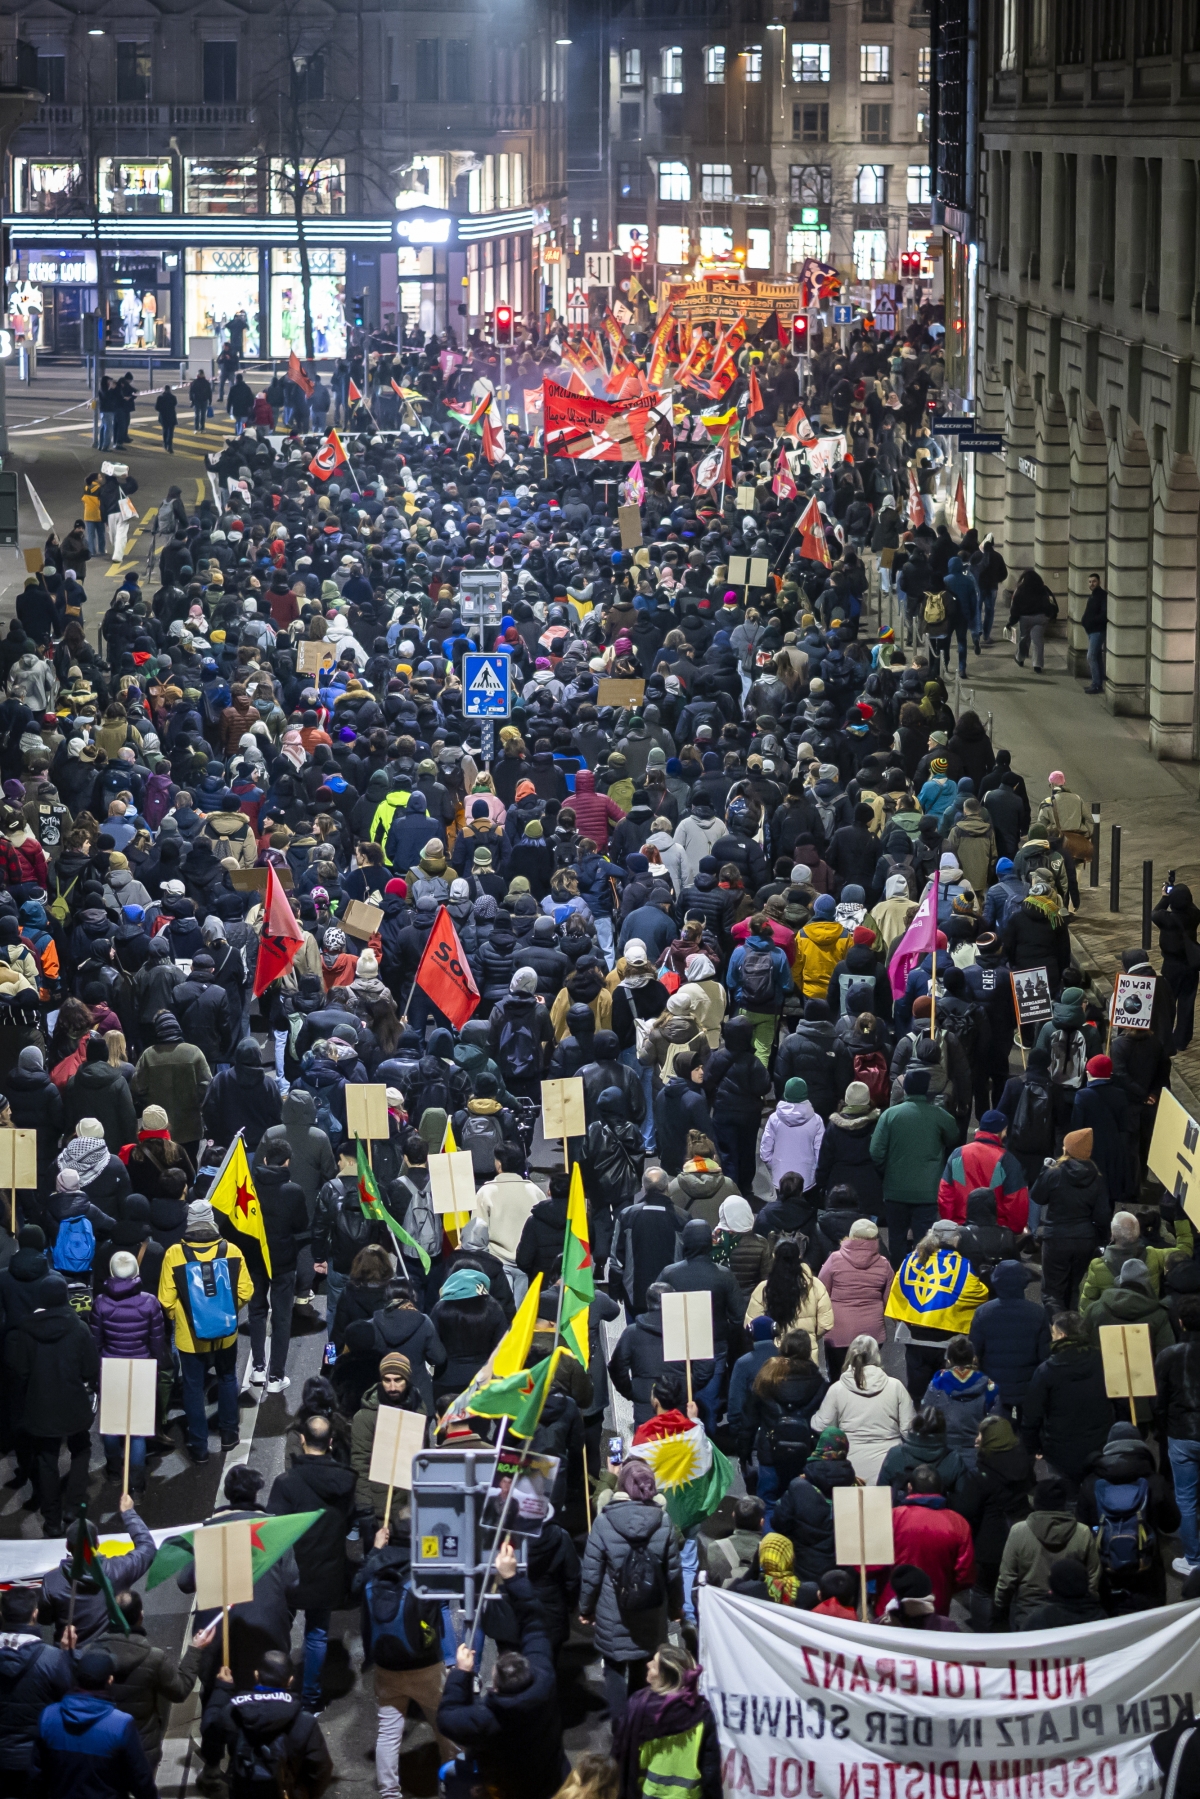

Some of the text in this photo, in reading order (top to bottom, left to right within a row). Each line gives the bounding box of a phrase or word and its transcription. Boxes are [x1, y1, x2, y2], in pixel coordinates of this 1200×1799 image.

[1120, 979, 1131, 988] NO
[1115, 1007, 1125, 1016] NO
[1115, 1016, 1150, 1027] POVERTY
[254, 1692, 293, 1703] SQUAD
